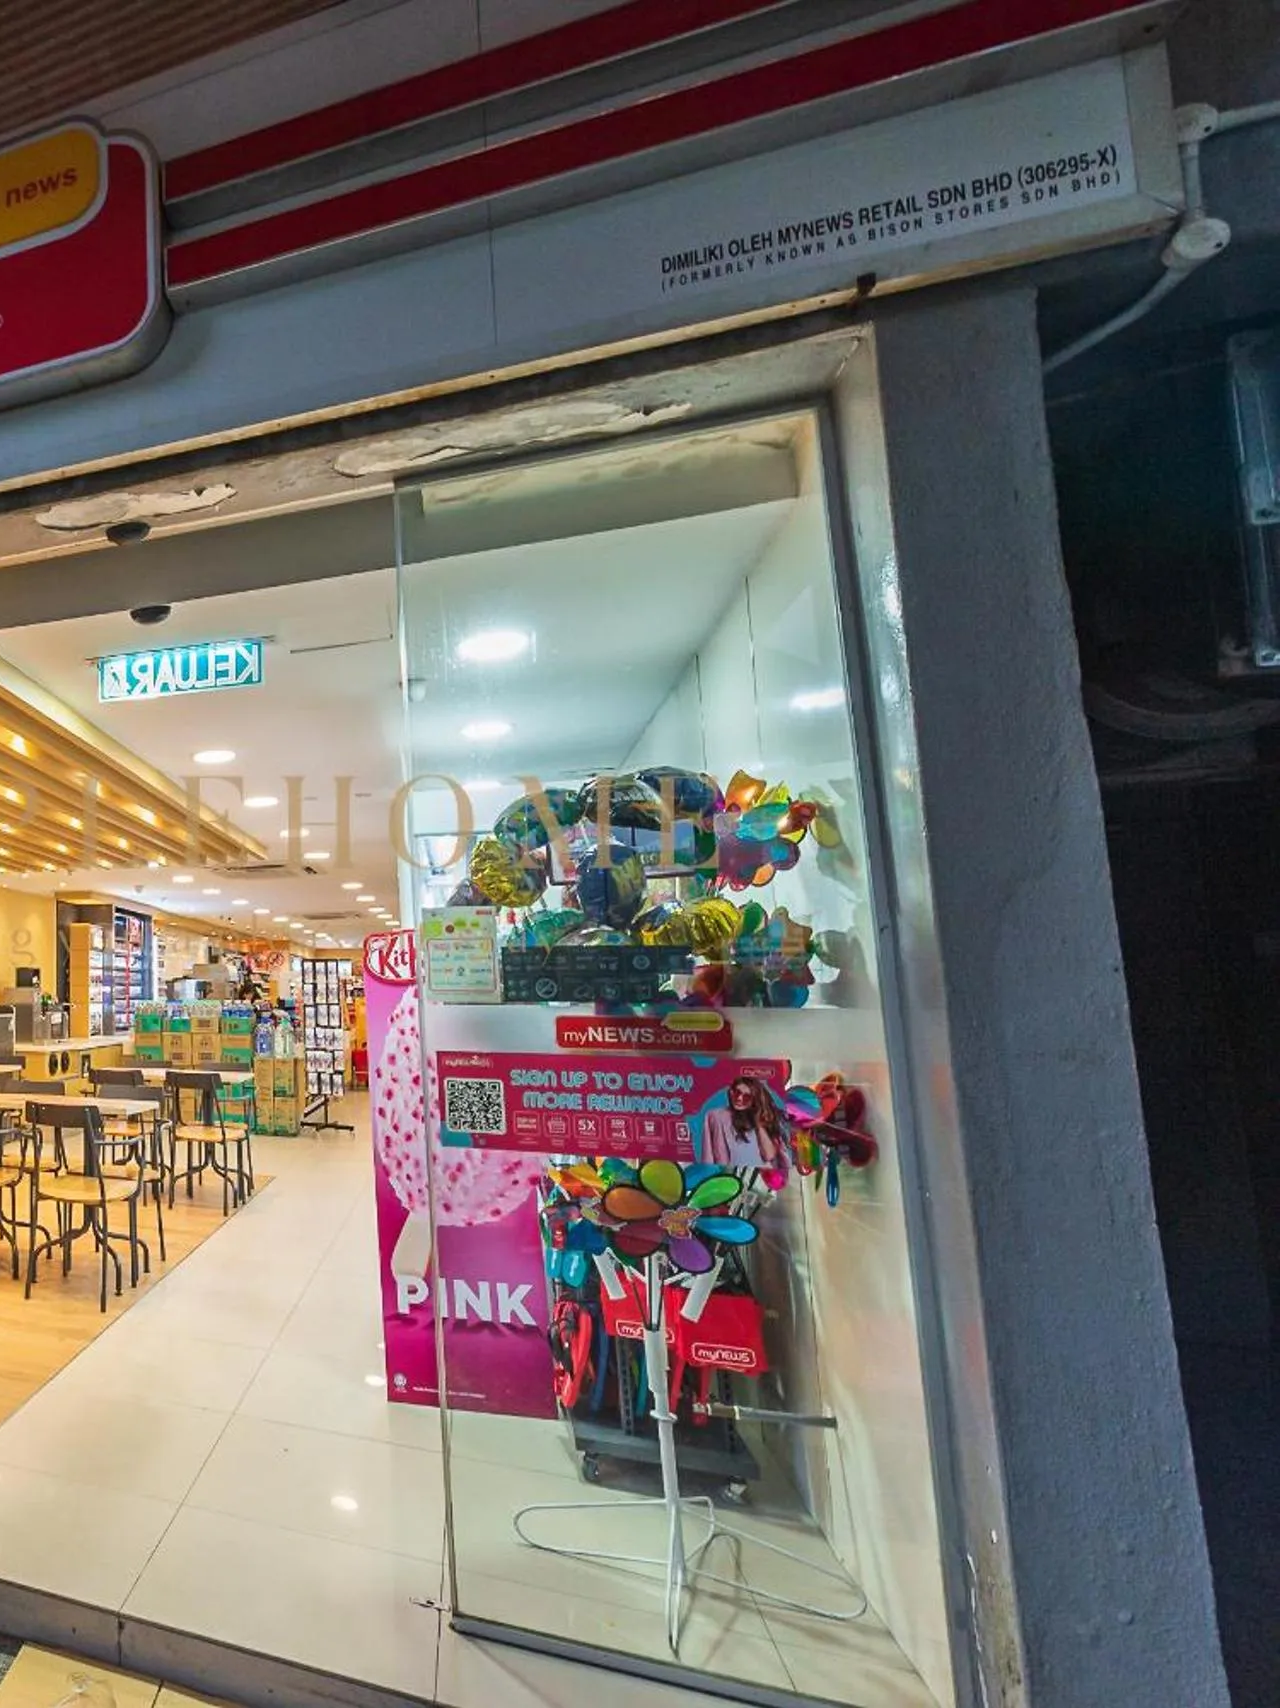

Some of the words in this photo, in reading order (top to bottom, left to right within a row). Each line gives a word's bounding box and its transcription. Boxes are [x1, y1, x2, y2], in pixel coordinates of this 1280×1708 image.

[5, 167, 78, 208] news
[661, 243, 724, 274] DIMILIKI
[728, 231, 773, 258] OLEH
[777, 211, 854, 246] MYNEWS
[858, 195, 923, 226] RETAIL
[927, 182, 967, 209] SDN
[972, 172, 1013, 199] BHD
[1017, 144, 1117, 188] (306295-X)
[661, 256, 755, 292] (FORMERLY
[765, 243, 825, 265] KNOWN
[836, 234, 857, 249] AS
[868, 217, 923, 240] BISON
[935, 196, 1009, 226] STORES
[1021, 184, 1059, 205] SDN
[1071, 169, 1121, 193] BHD)
[523, 1091, 582, 1111] MORE
[561, 1070, 588, 1089] UP
[592, 1071, 622, 1090] TO
[396, 1273, 537, 1326] PINK
